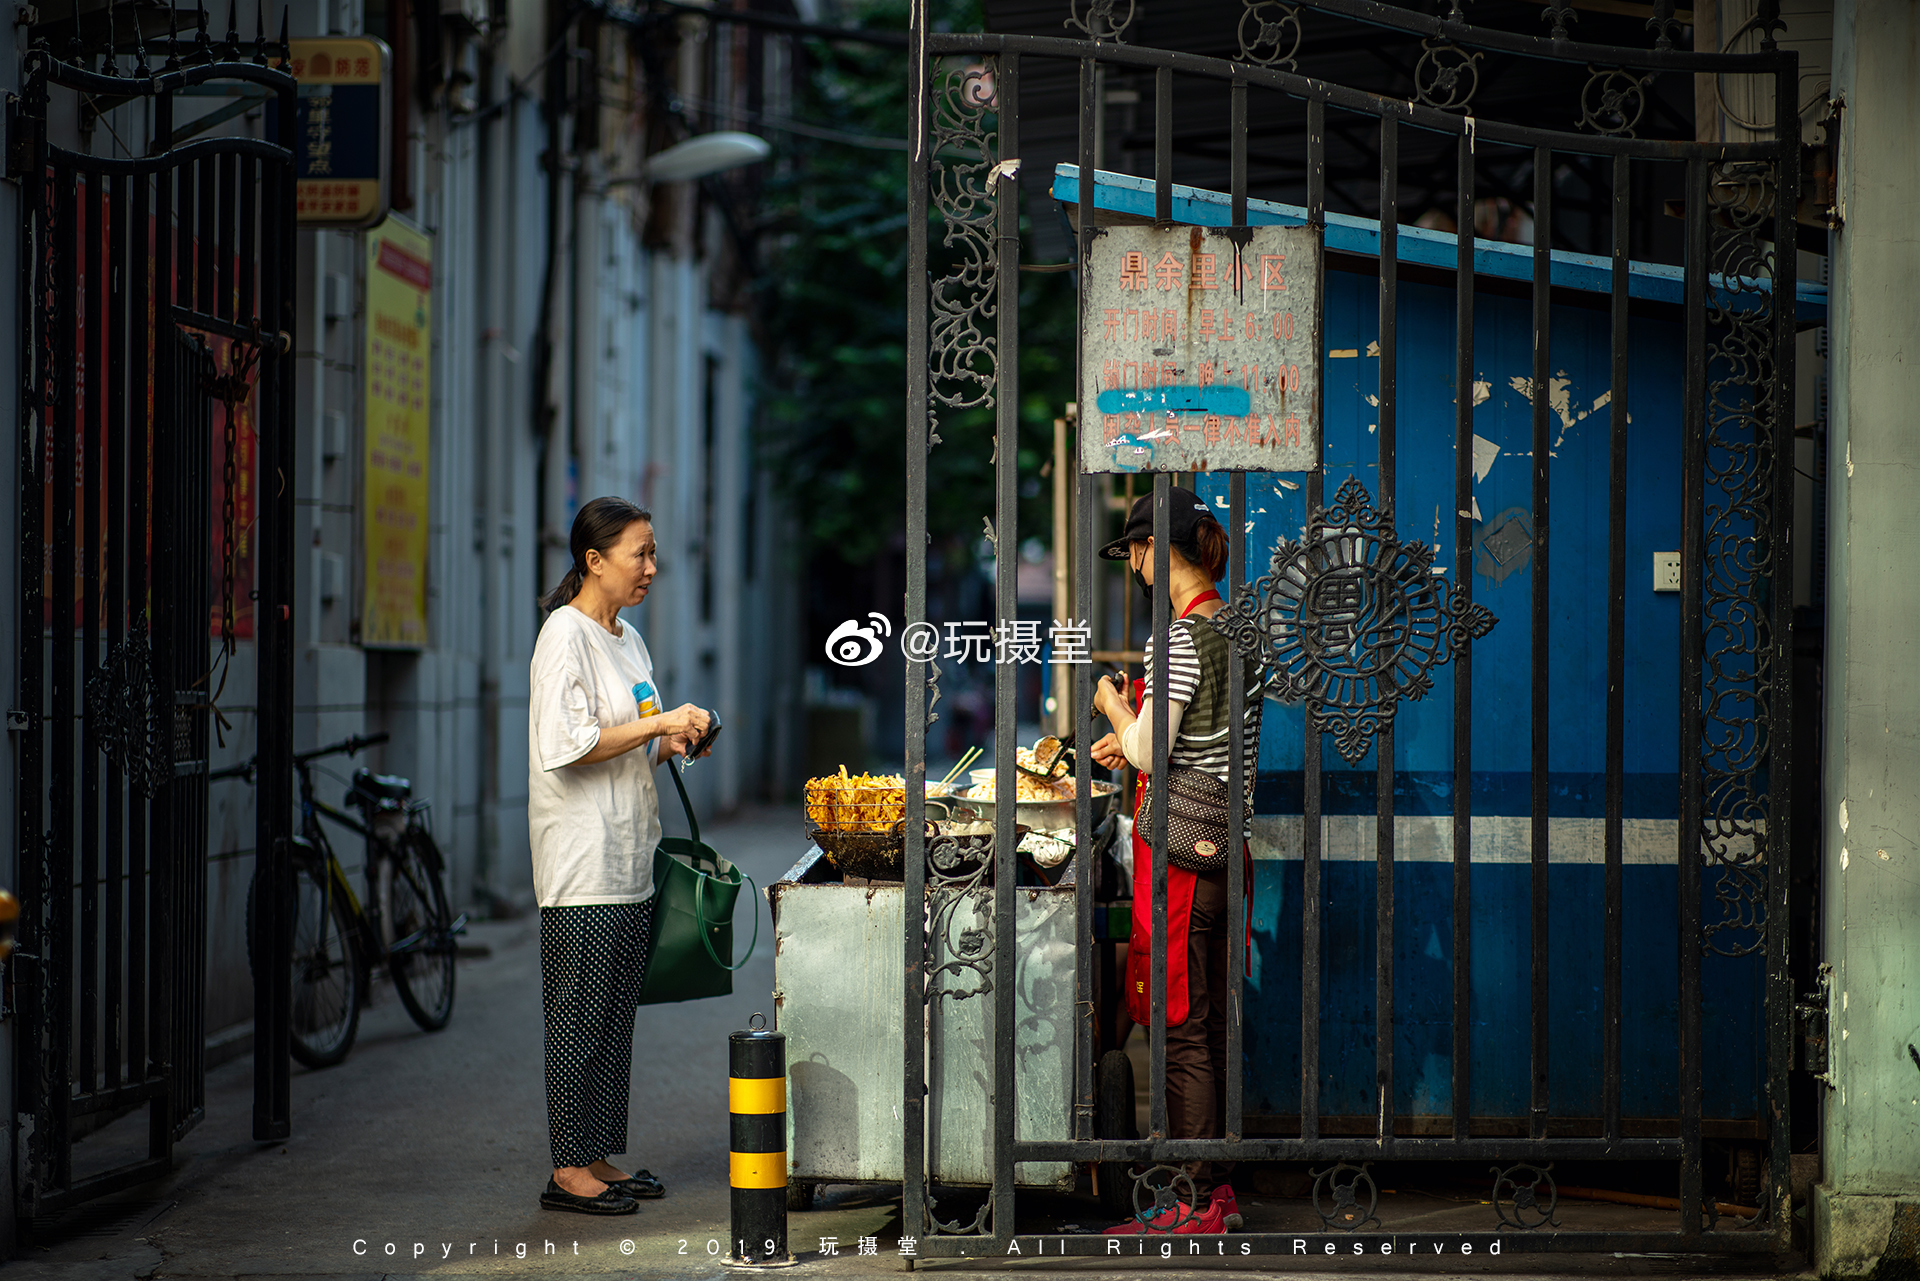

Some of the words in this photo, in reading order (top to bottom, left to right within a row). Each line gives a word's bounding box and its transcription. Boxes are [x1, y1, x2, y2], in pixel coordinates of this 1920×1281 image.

[1119, 250, 1288, 291] 鼎余里小区
